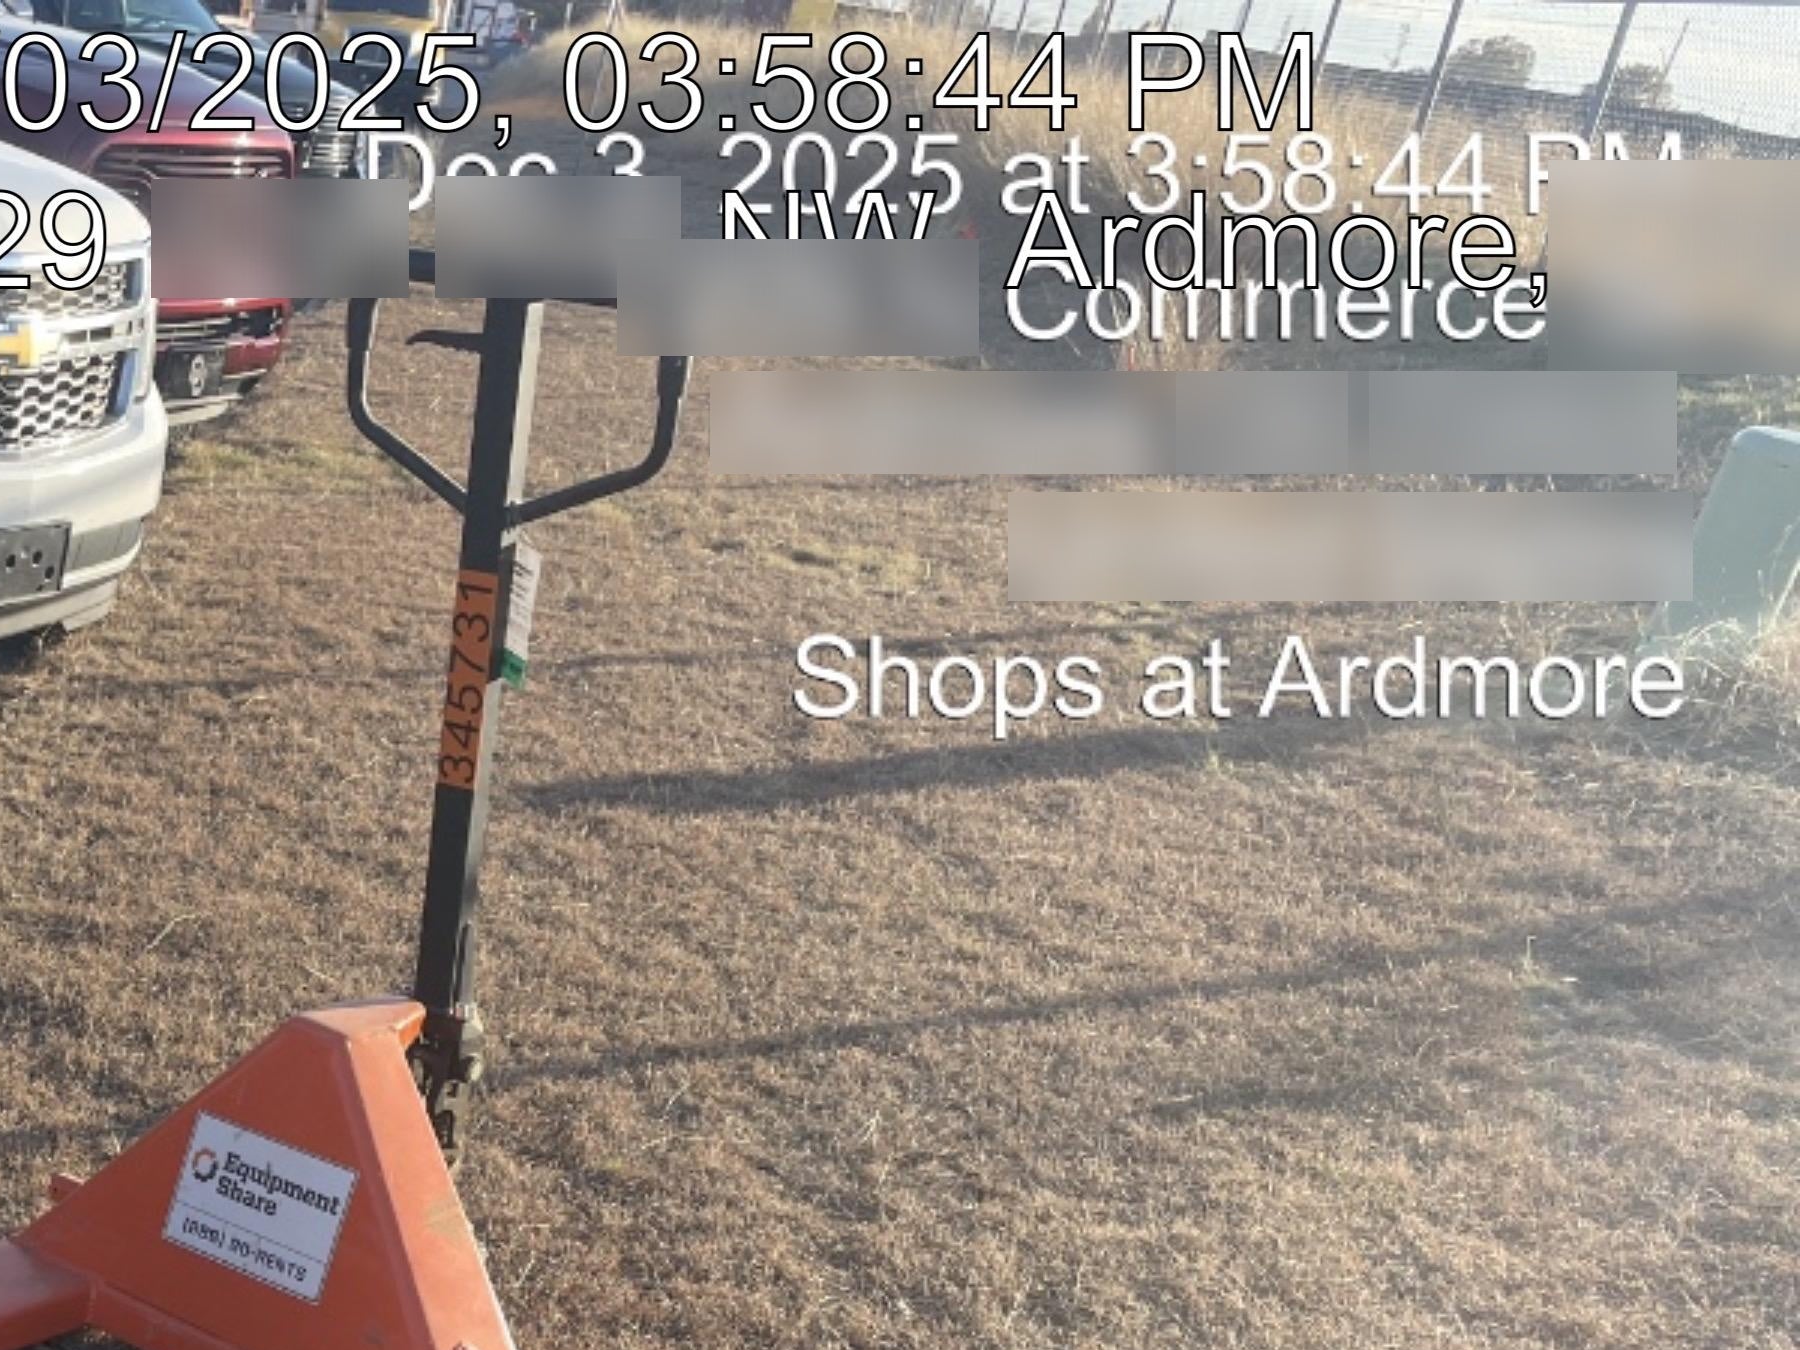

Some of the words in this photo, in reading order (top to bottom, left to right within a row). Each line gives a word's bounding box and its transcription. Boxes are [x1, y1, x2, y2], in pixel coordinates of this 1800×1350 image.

[438, 579, 495, 784] 345731
[215, 1176, 278, 1216] Share
[222, 1152, 341, 1216] Equipment
